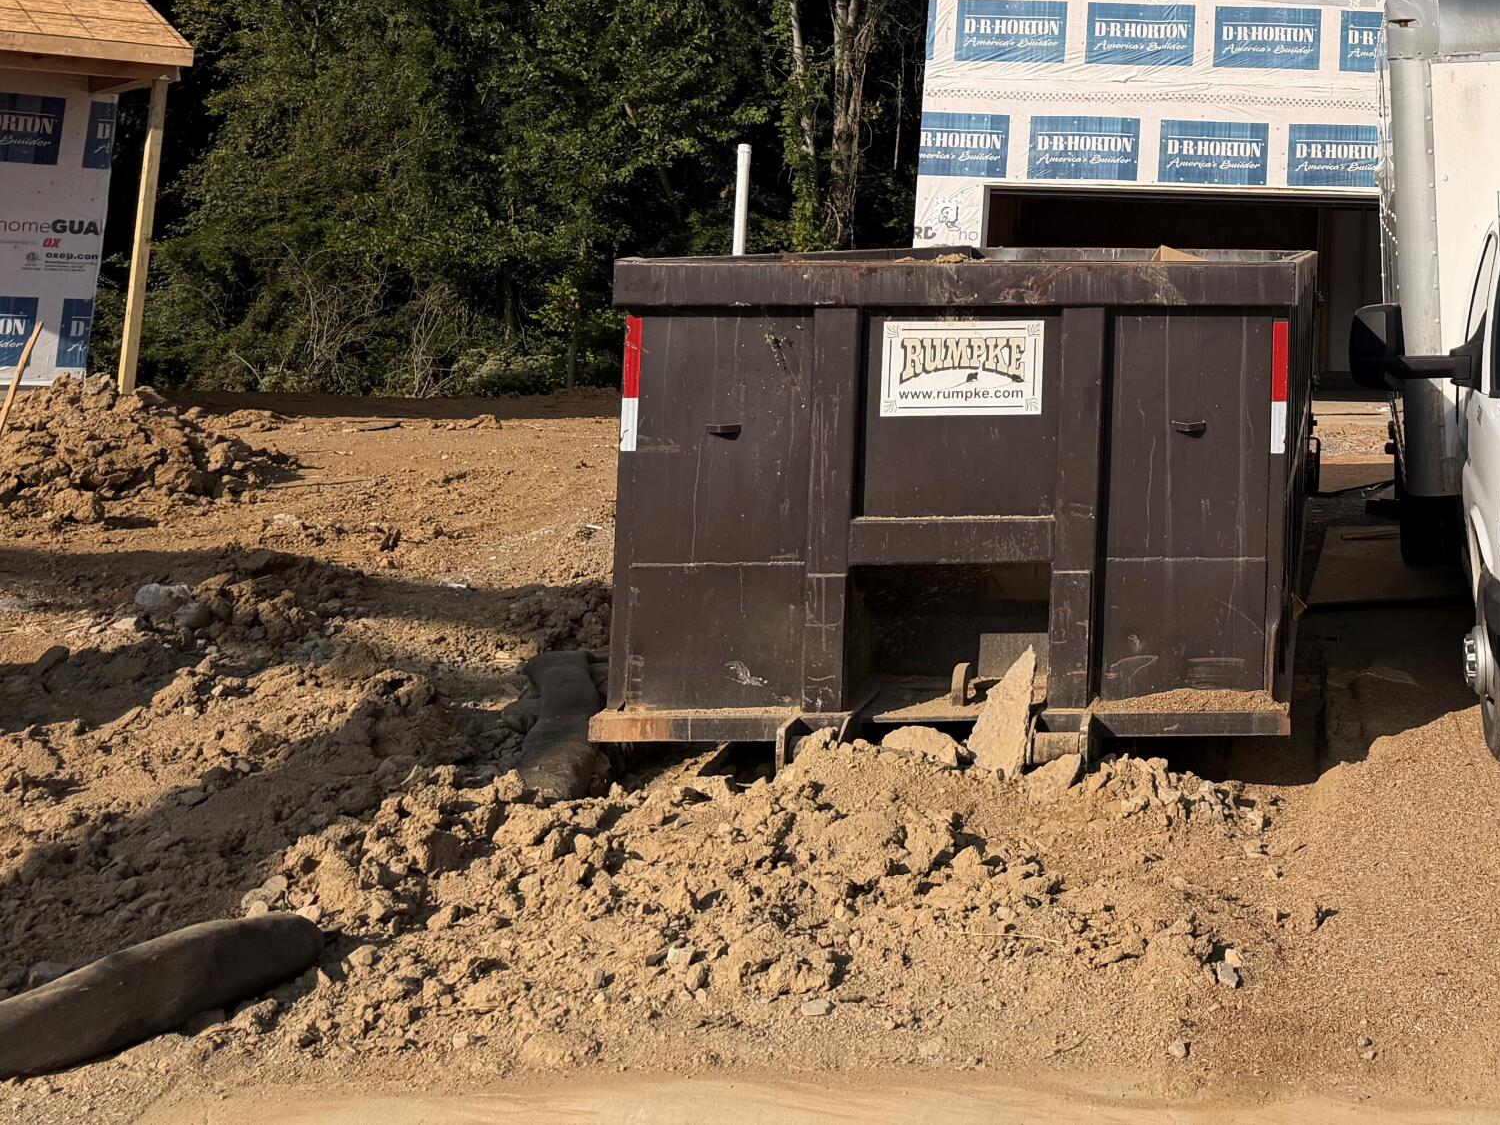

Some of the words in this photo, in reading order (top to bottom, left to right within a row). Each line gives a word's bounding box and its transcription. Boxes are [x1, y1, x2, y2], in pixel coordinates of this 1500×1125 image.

[958, 151, 1001, 162] Builder
[1035, 154, 1088, 165] America's
[1089, 154, 1132, 165] Builder
[1166, 157, 1217, 169] America's
[1219, 159, 1261, 169] Builder
[43, 238, 61, 248] OX
[899, 337, 1026, 385] RUMPKE
[899, 388, 1024, 401] www.rumpke.com
